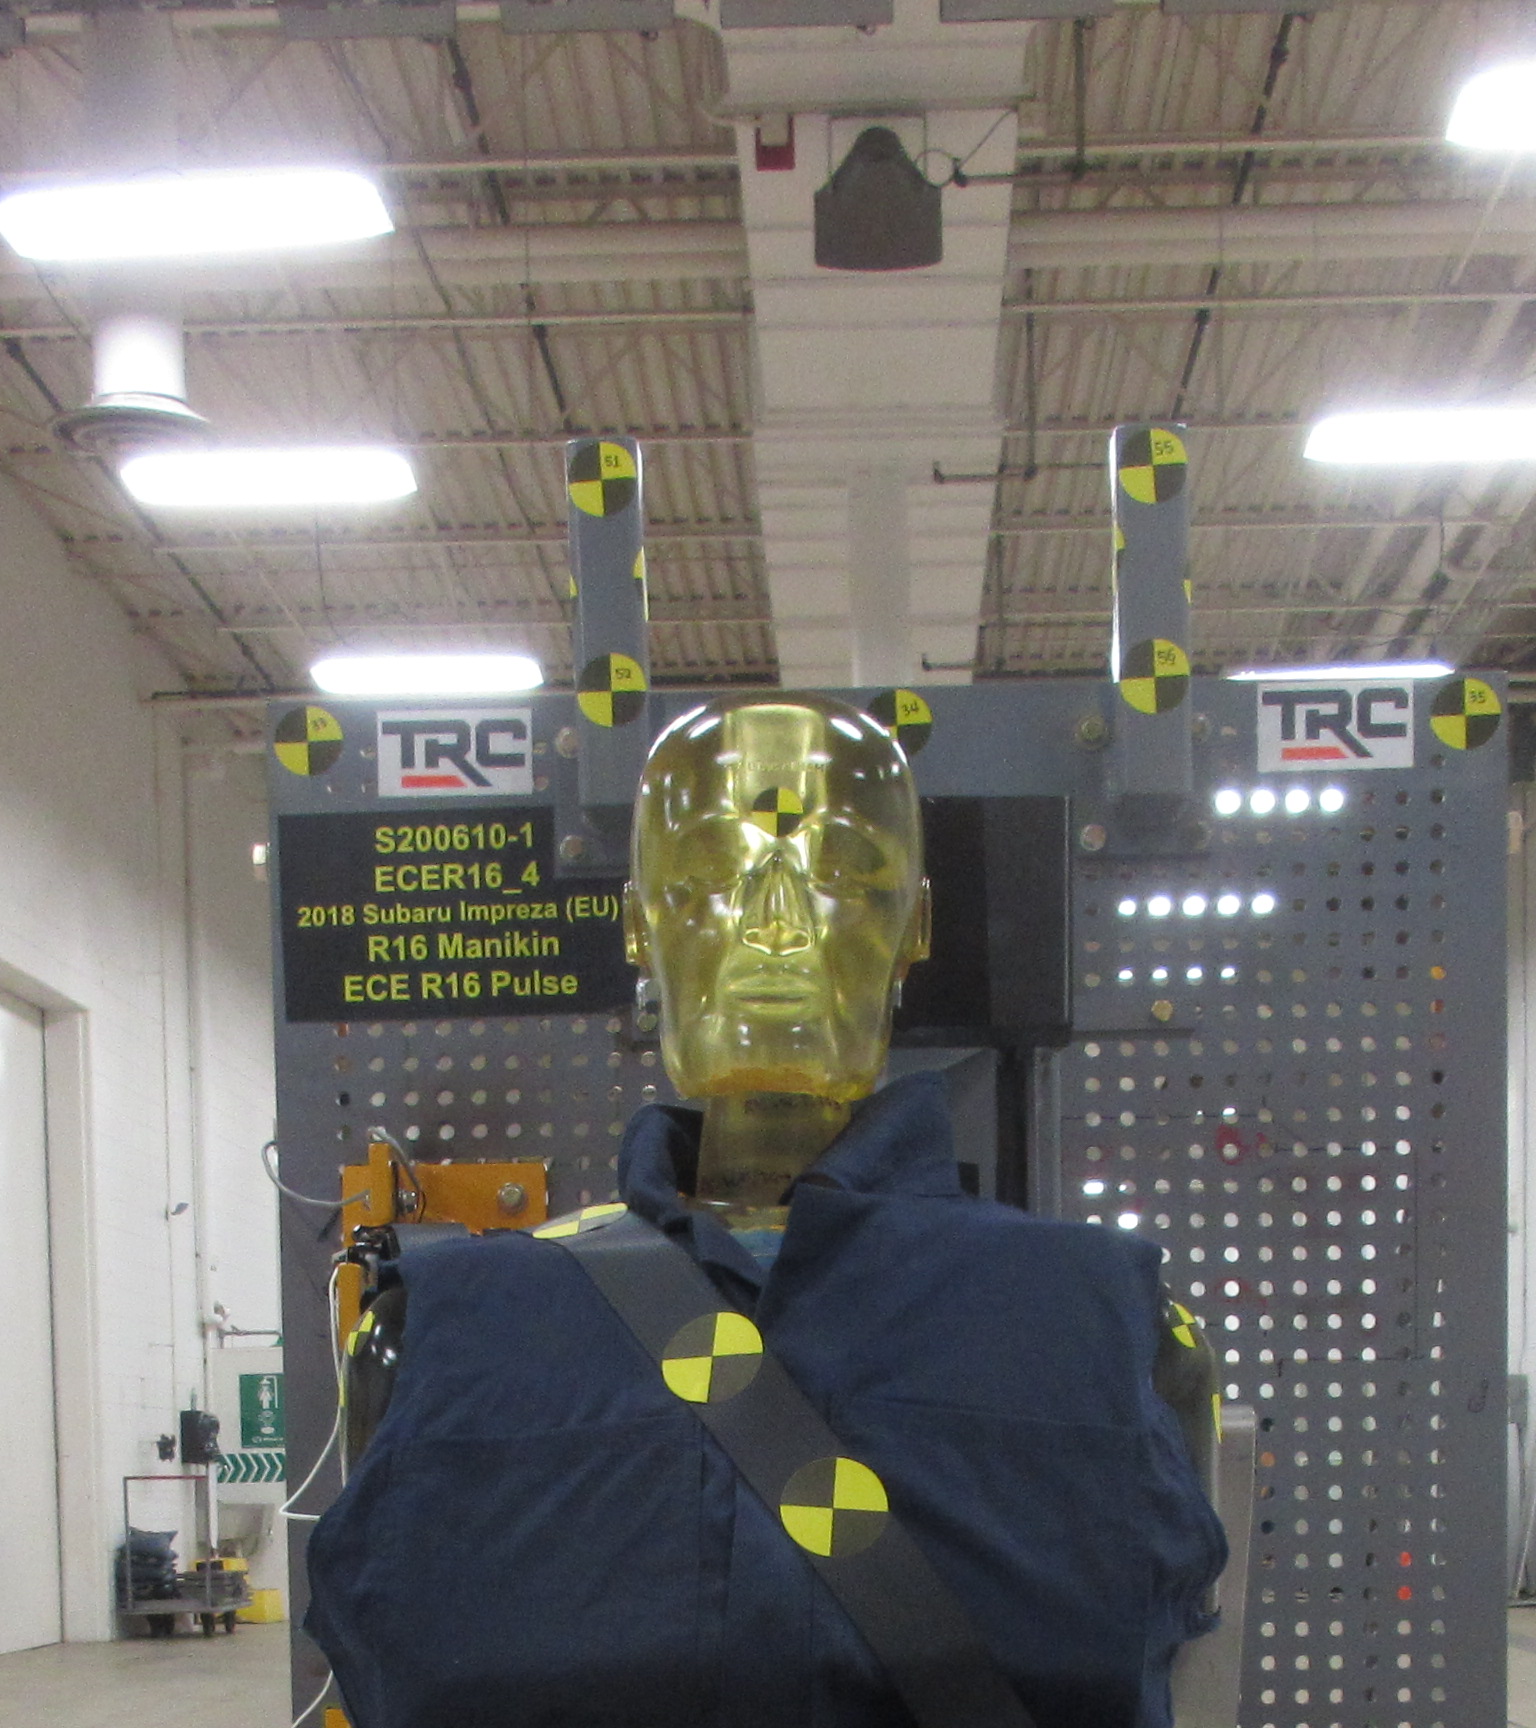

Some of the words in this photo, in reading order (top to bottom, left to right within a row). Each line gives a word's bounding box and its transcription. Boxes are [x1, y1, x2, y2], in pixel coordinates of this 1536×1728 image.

[1262, 687, 1408, 757] TRC
[381, 718, 527, 787] TRC
[374, 823, 535, 854] S200610-1
[374, 861, 540, 894] ECER16_4
[297, 905, 356, 928] 2018
[363, 901, 452, 925] Subaru
[460, 899, 558, 926] Impreza
[565, 895, 619, 922] (EU)
[368, 935, 428, 962] R16
[437, 930, 560, 960] Manikin
[344, 974, 410, 1003] ECE
[421, 971, 481, 999] R16
[491, 968, 579, 997] Pulse
